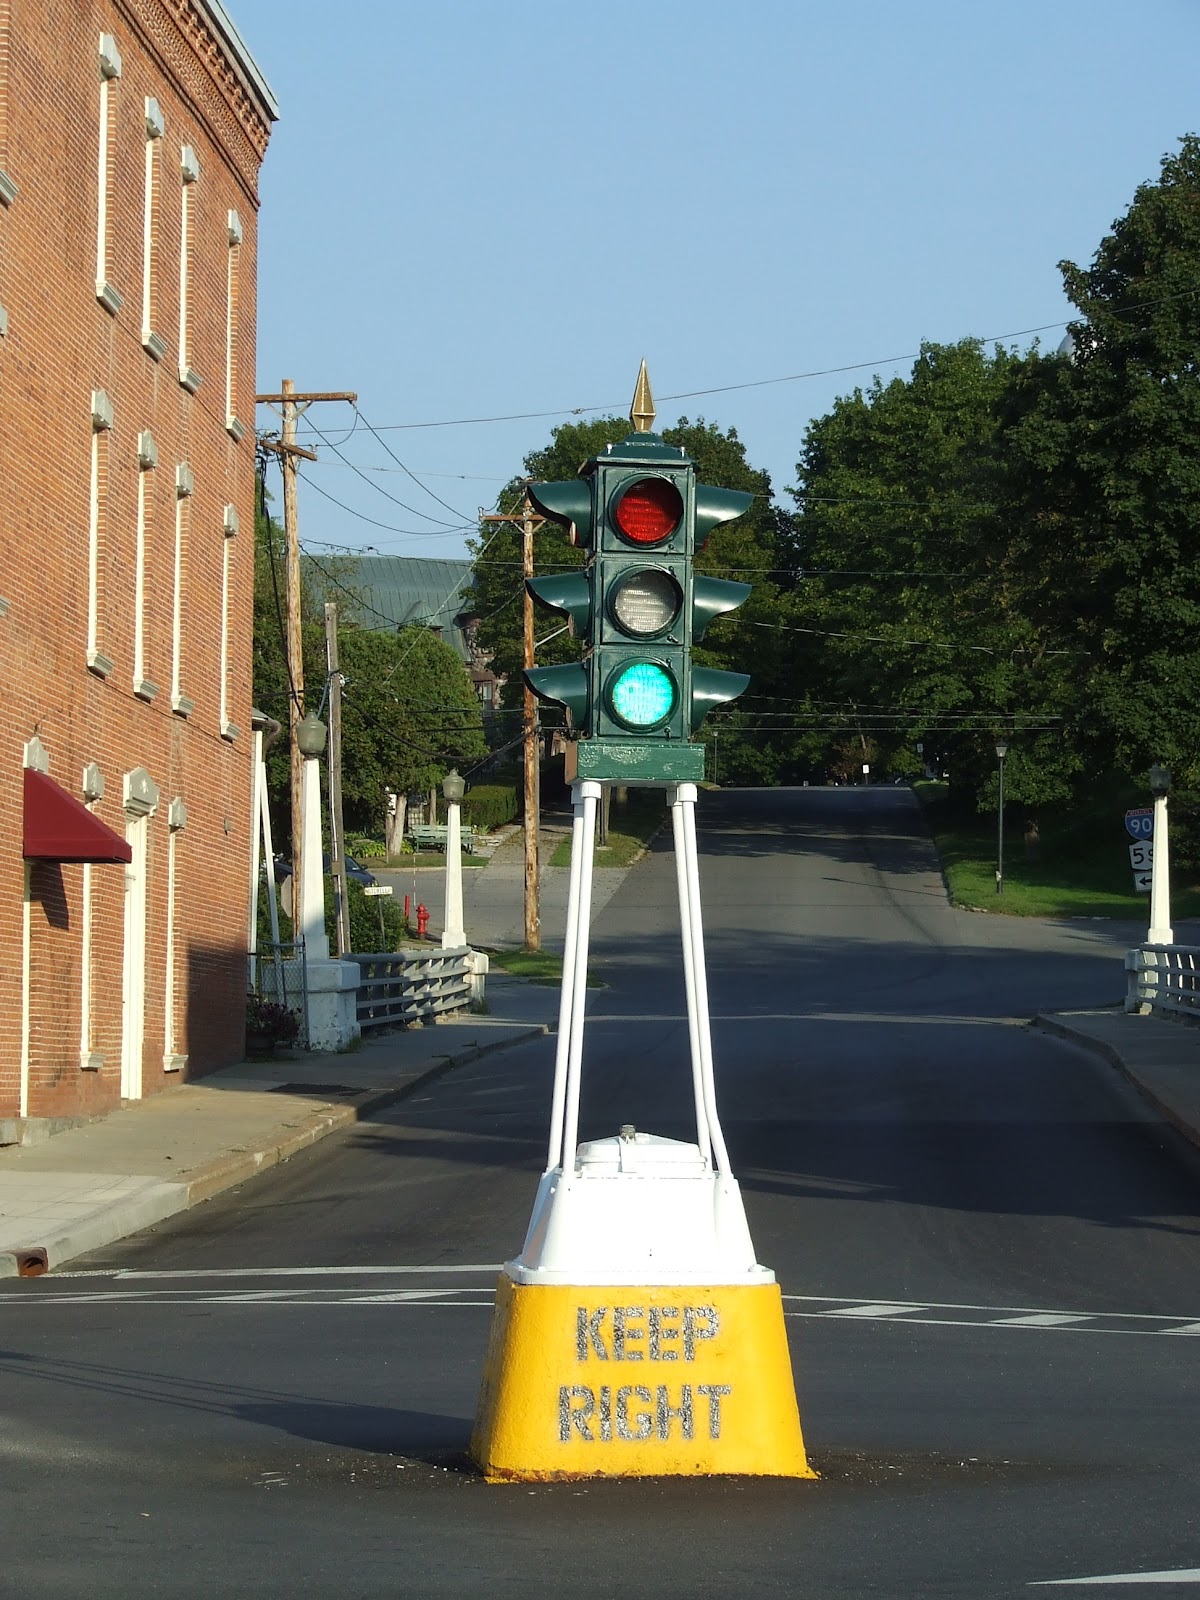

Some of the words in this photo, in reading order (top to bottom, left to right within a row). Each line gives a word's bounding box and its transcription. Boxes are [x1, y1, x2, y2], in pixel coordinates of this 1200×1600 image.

[1131, 818, 1152, 833] 90
[577, 1306, 719, 1361] KEEP
[559, 1384, 731, 1442] RIGHT
